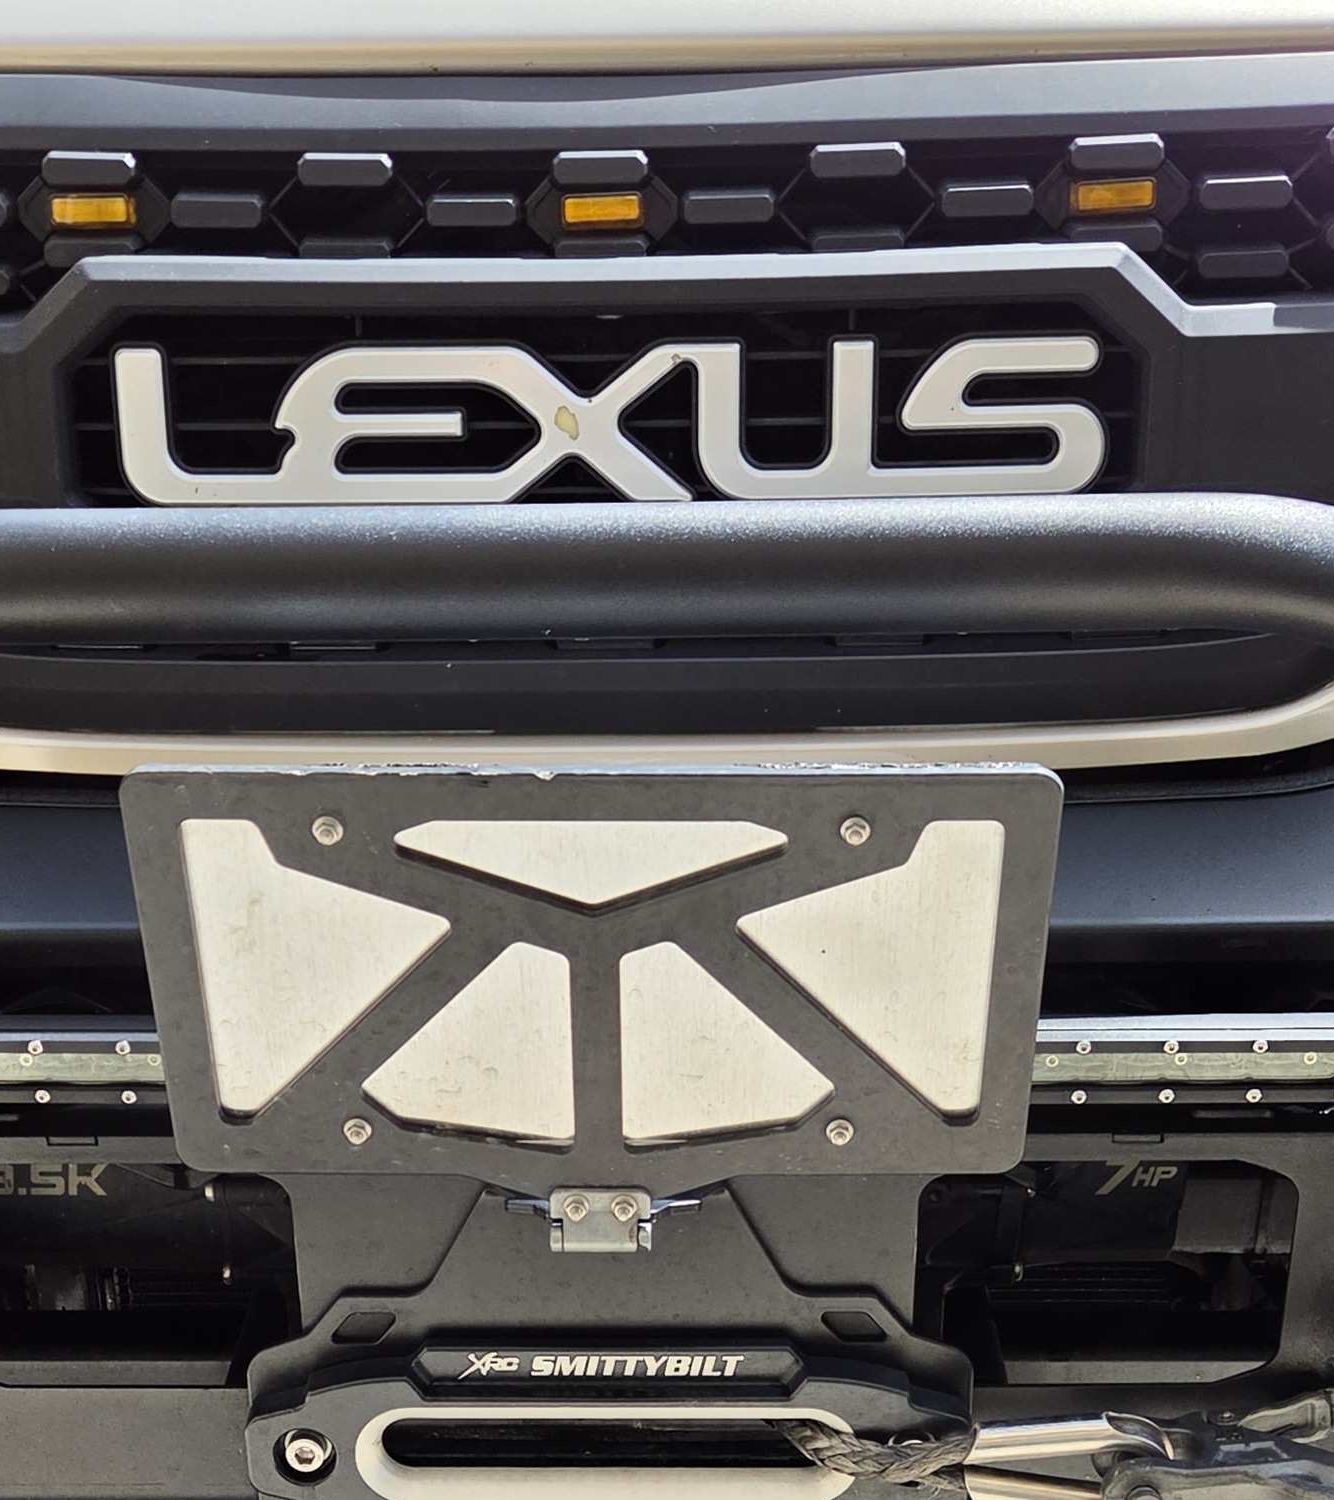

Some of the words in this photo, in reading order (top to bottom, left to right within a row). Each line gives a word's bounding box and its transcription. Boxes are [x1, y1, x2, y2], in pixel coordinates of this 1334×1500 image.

[114, 336, 1106, 504] LEXUS
[457, 1352, 521, 1380] XRC
[530, 1355, 745, 1377] SMITTYBILT
